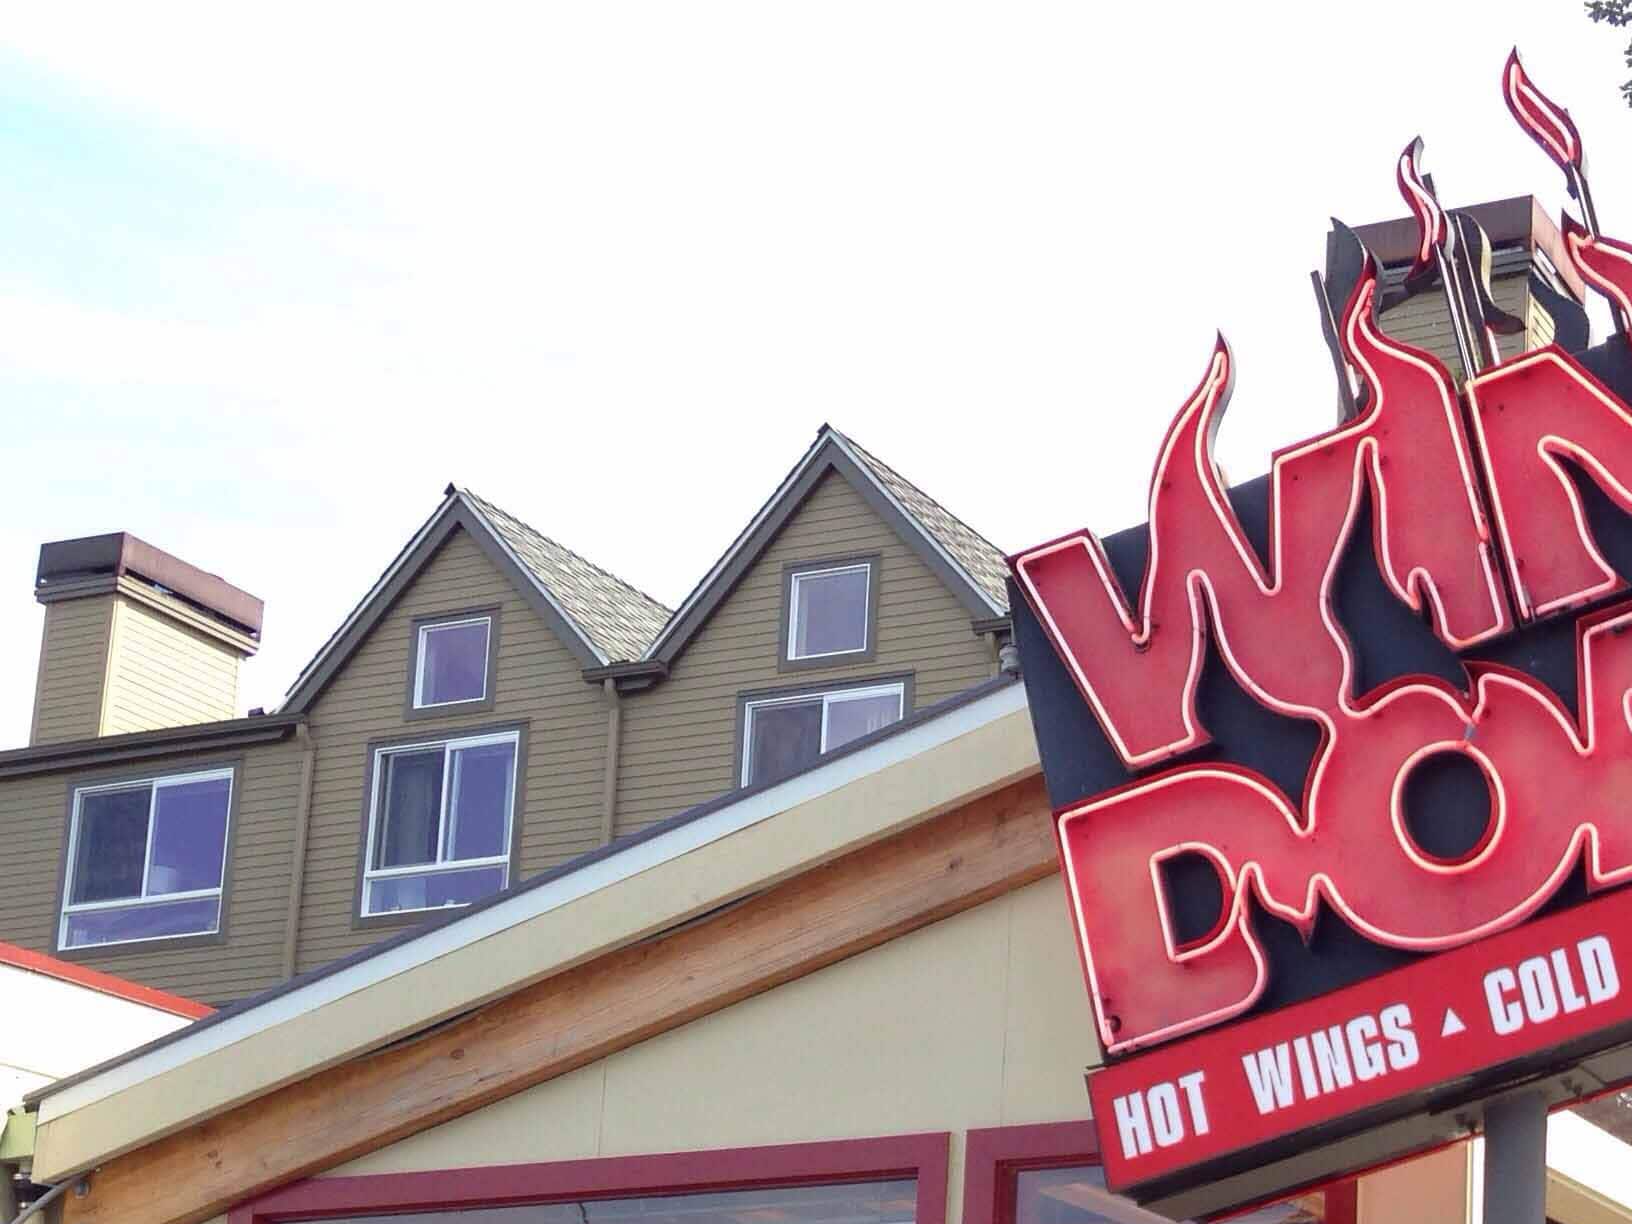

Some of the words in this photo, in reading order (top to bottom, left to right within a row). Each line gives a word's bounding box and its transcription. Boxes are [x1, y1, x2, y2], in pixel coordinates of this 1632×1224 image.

[1112, 1070, 1211, 1161] HOT
[1242, 1003, 1421, 1116] WINGS
[1482, 934, 1621, 1036] COLD
